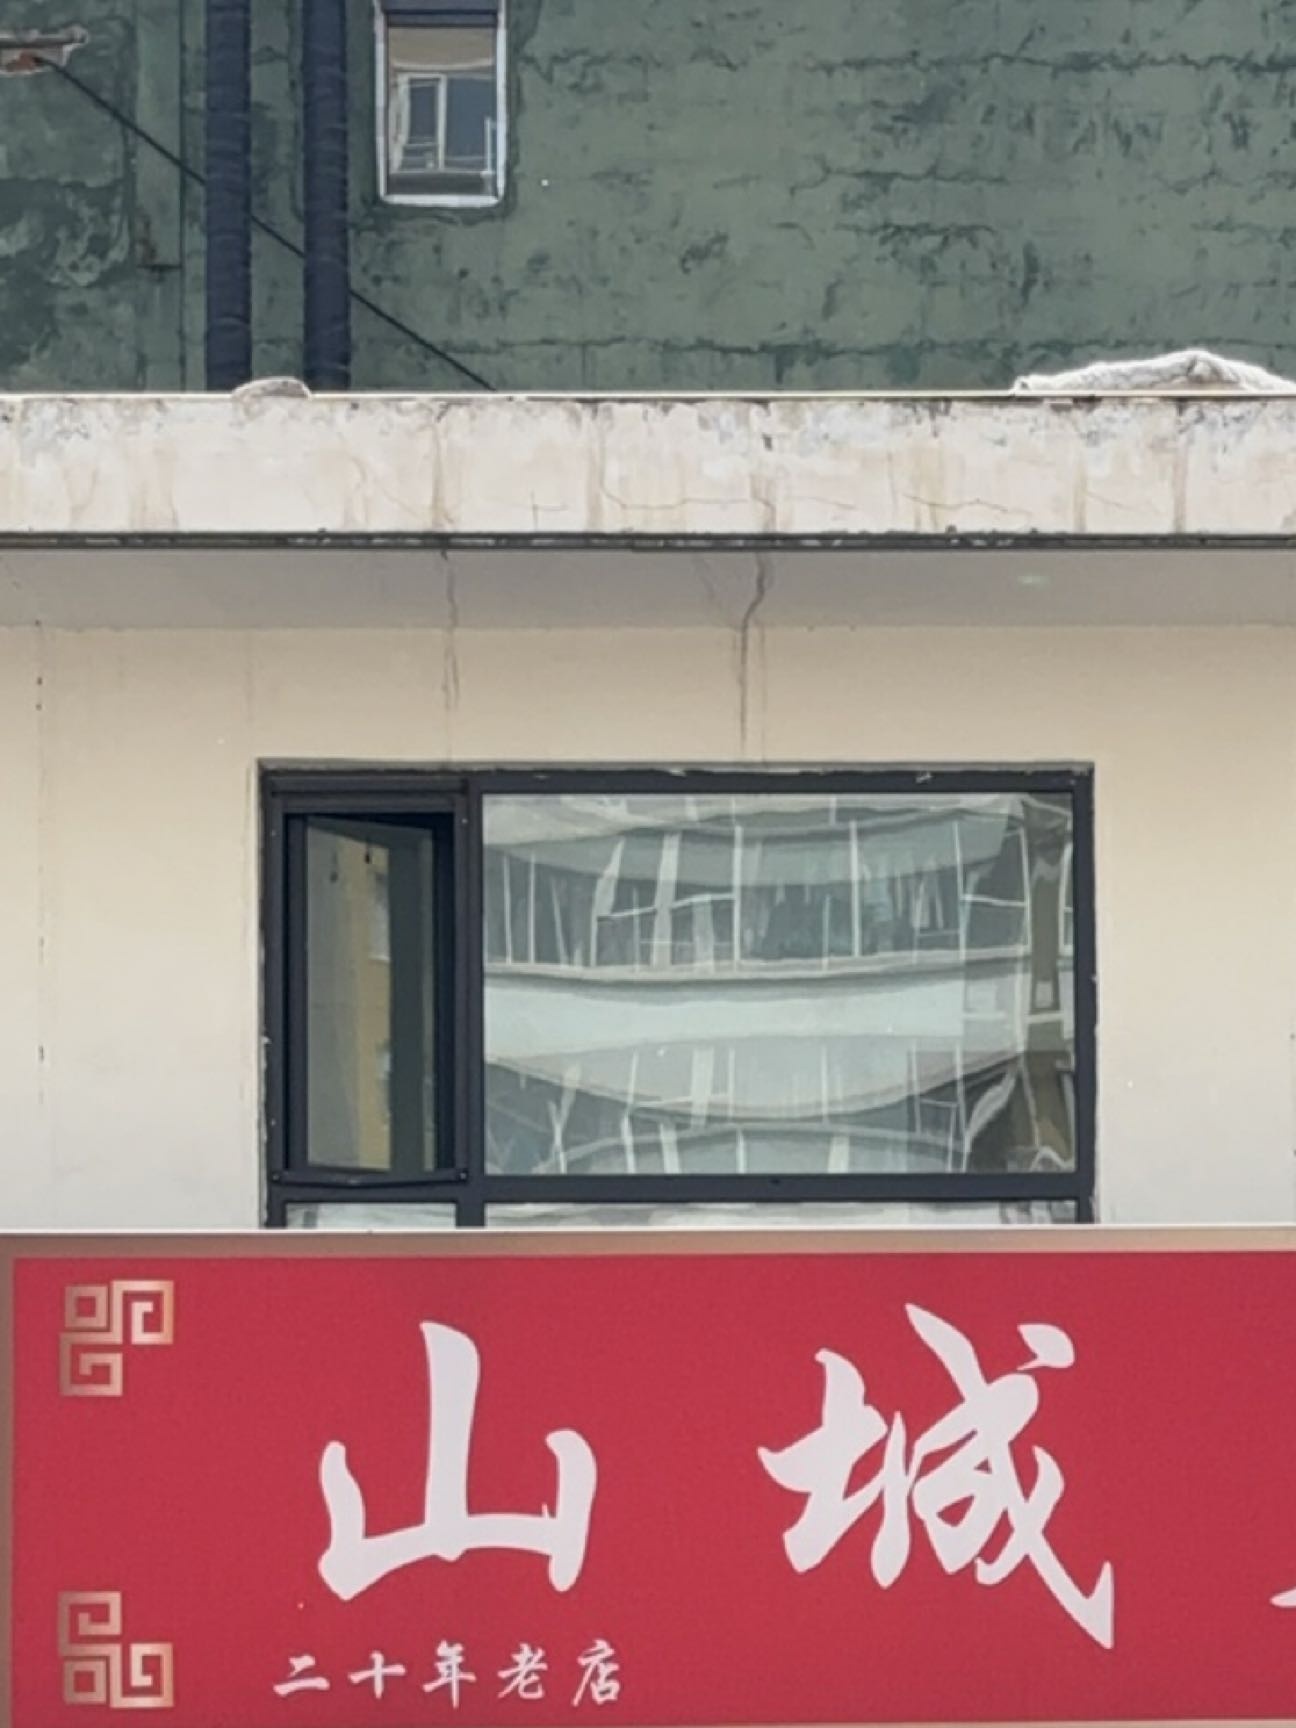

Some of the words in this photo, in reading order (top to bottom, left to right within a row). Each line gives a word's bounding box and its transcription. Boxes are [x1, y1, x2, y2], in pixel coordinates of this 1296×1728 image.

[273, 1638, 622, 1708] 二十年老店
